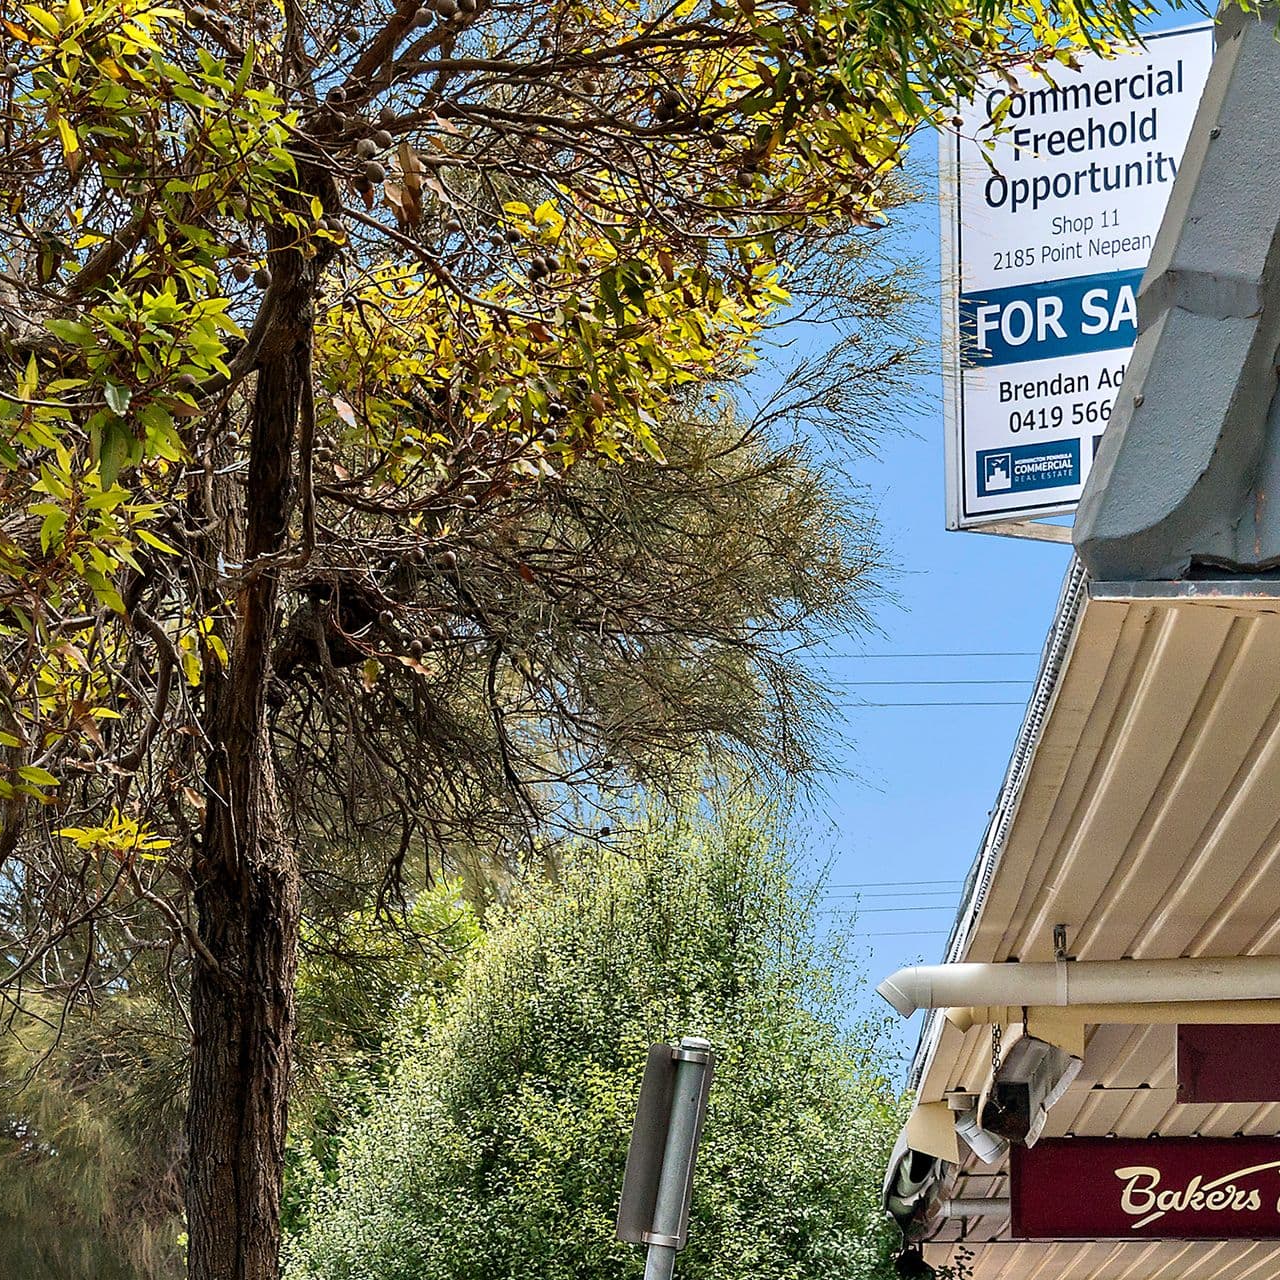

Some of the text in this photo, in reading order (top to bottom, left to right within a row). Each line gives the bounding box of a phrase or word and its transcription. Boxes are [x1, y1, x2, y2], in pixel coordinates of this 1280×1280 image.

[986, 60, 1183, 120] Commercial
[1014, 108, 1157, 161] Freehold
[1052, 209, 1120, 236] Shop 11
[993, 234, 1151, 271] 2185 Point Nepean
[977, 296, 1068, 350] FOR
[999, 373, 1089, 403] Brendan
[1009, 399, 1111, 433] 0419 566
[1014, 459, 1073, 475] COMMERCIAL
[1041, 469, 1073, 480] ESTATE
[1114, 1166, 1262, 1229] Bakers
